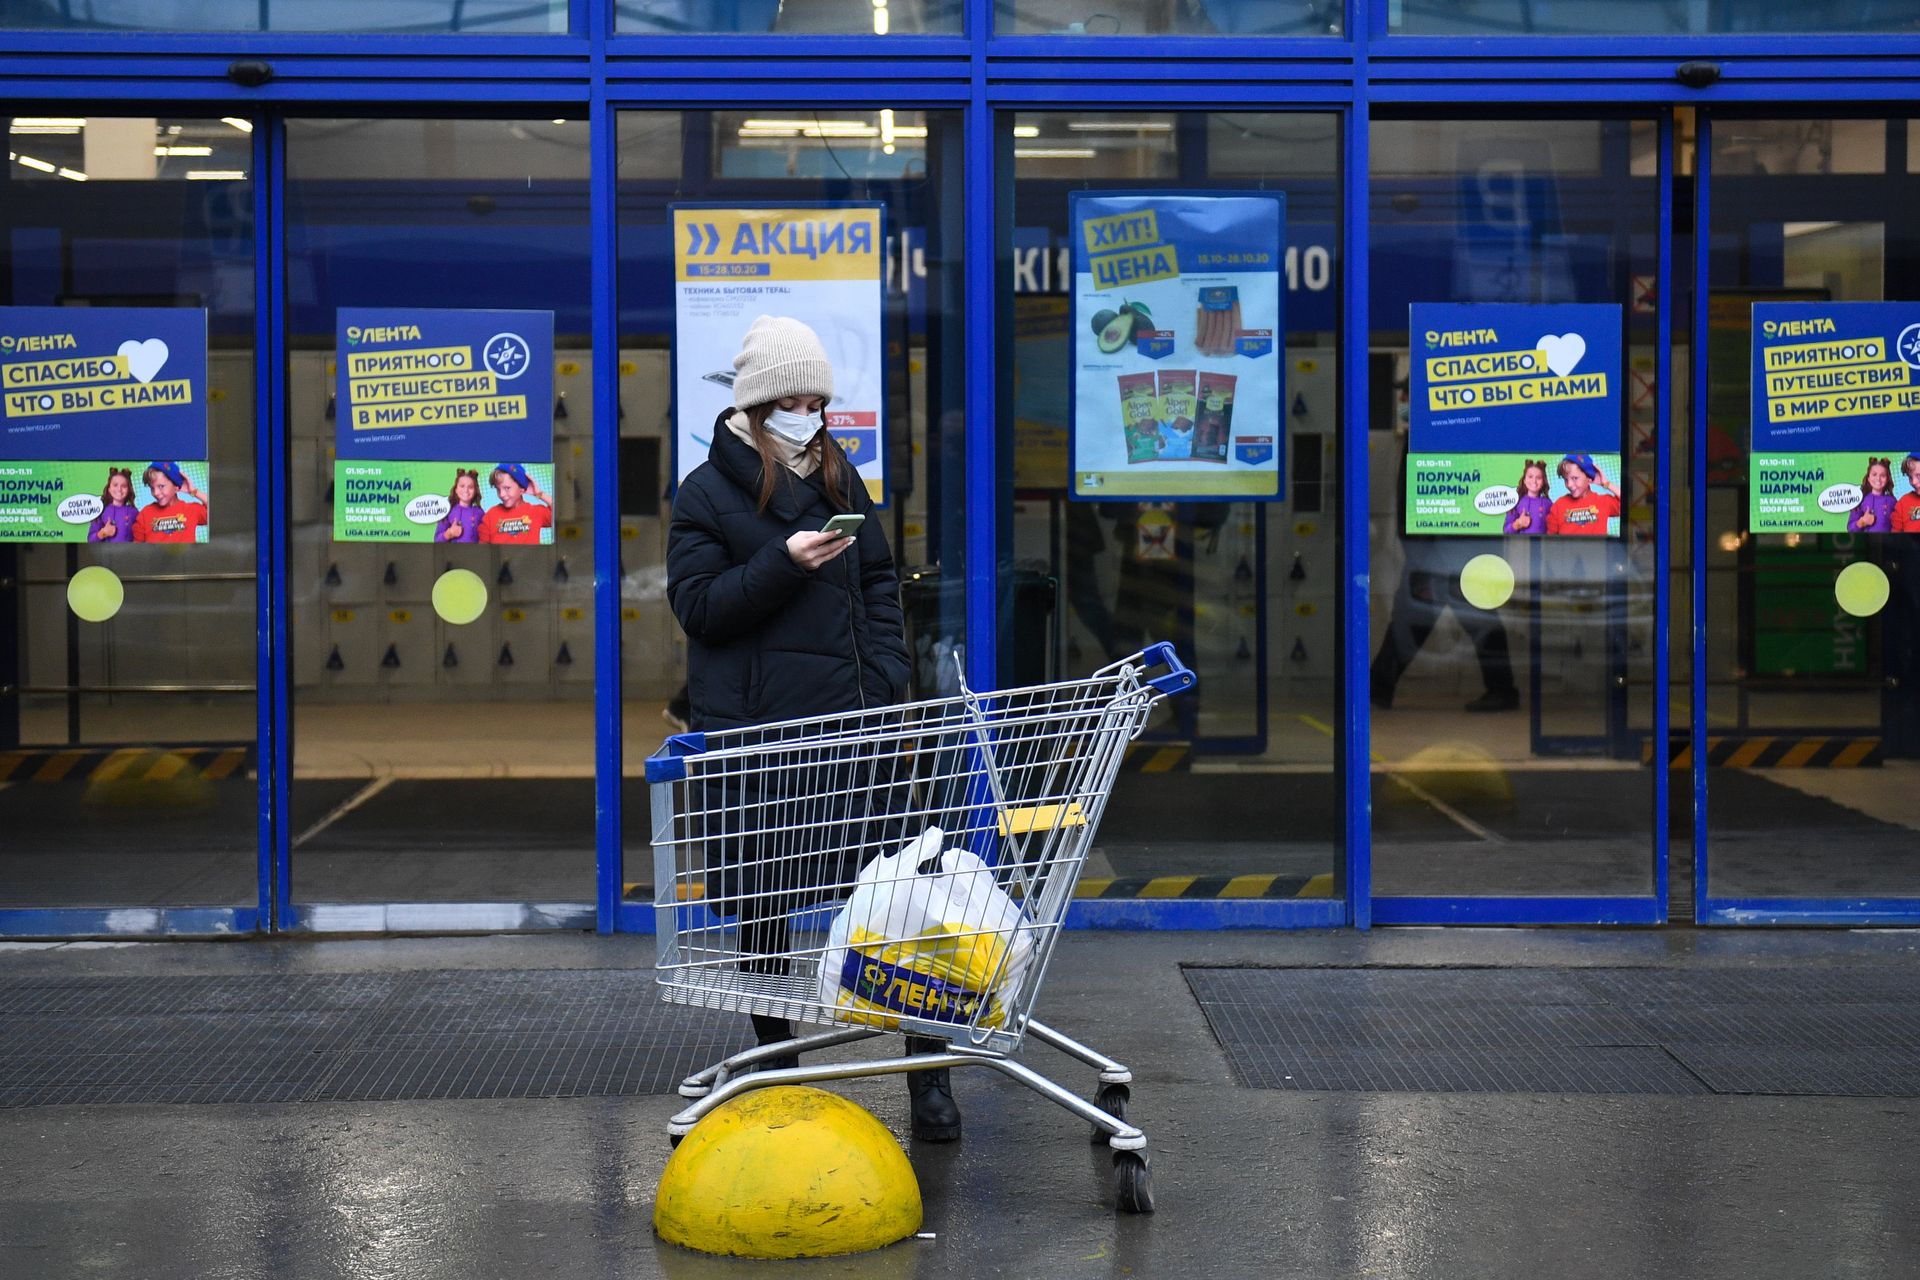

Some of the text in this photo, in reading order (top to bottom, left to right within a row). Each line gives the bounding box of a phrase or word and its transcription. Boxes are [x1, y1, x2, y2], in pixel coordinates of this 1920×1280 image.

[1093, 216, 1151, 248] ХИТ!
[731, 222, 871, 260] АКЦИЯ
[699, 265, 758, 275] 15-28.10.20
[1097, 254, 1171, 286] ЦЕНА
[683, 286, 791, 295] ТЕХНИКА БЫТОВАЯ TEFAL:
[362, 325, 421, 343] ЛЕНТА
[1778, 318, 1836, 337] ЛЕНТА
[16, 334, 76, 352] ЛЕНТА
[1440, 329, 1498, 347] ЛЕНТА
[1771, 343, 1879, 366] ПРИЯТНОГО
[355, 352, 465, 373] ПРИЯТНОГО
[1433, 354, 1540, 377] СПАСИБО,
[9, 360, 122, 383] СПАСИБО,
[1773, 367, 1903, 392] ПУТЕШЕСТВИЯ
[357, 377, 490, 398] ПУТЕШЕСТВИЯ
[1435, 377, 1600, 406] ЧТО ВЫ С НАМИ
[12, 384, 185, 413] ЧТО ВЫ С НАМИ
[1775, 391, 1920, 417] В МИР СУПЕР ЦЕ
[359, 401, 520, 424] В МИР СУПЕР ЦЕН
[828, 414, 856, 426] -37%
[1416, 470, 1480, 483] ПОЛУЧАЙ
[1760, 468, 1824, 481] ПОЛУЧАЙ
[346, 479, 411, 491] ПОЛУЧАЙ
[1416, 485, 1469, 496] ШАРМЫ
[1760, 484, 1812, 494] ШАРМЫ
[346, 494, 399, 504] ШАРМЫ
[1485, 491, 1508, 500] СОБЕРИ
[1829, 489, 1852, 498] СОБЕРИ
[68, 499, 91, 508] СОБЕРИ
[416, 500, 439, 509] СОБЕРИ
[1478, 498, 1516, 508] КОЛЛЕКЦИЮ
[1822, 496, 1860, 507] КОЛЛЕКЦИЮ
[61, 507, 101, 517] КОЛЛЕКЦИЮ
[409, 507, 447, 517] КОЛЛЕКЦИЮ
